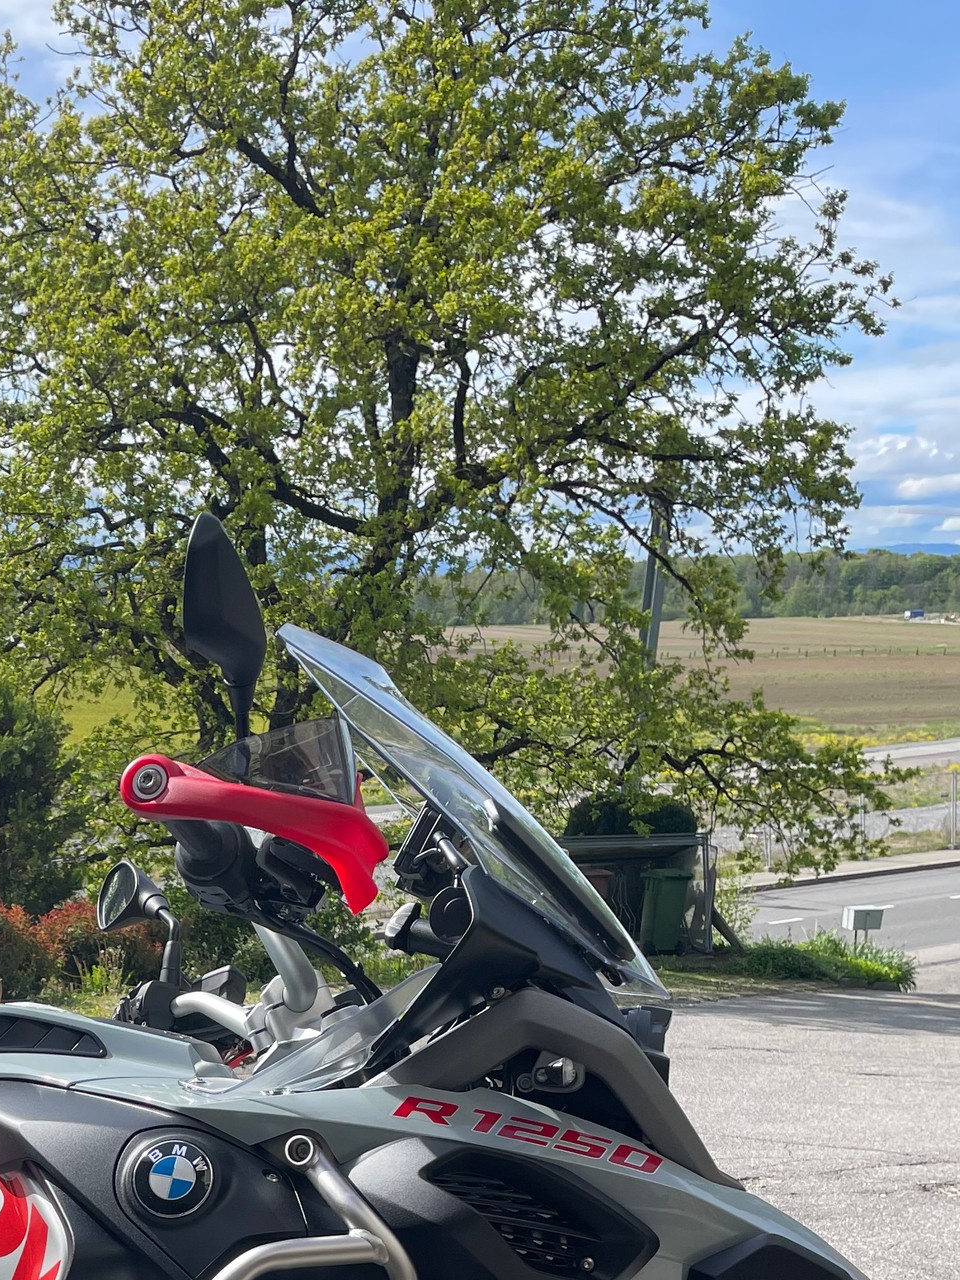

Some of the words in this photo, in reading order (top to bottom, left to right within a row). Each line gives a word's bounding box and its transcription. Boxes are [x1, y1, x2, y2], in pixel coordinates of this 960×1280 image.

[148, 1144, 208, 1171] BMW
[393, 1096, 459, 1126] R
[472, 1108, 664, 1174] 1250
